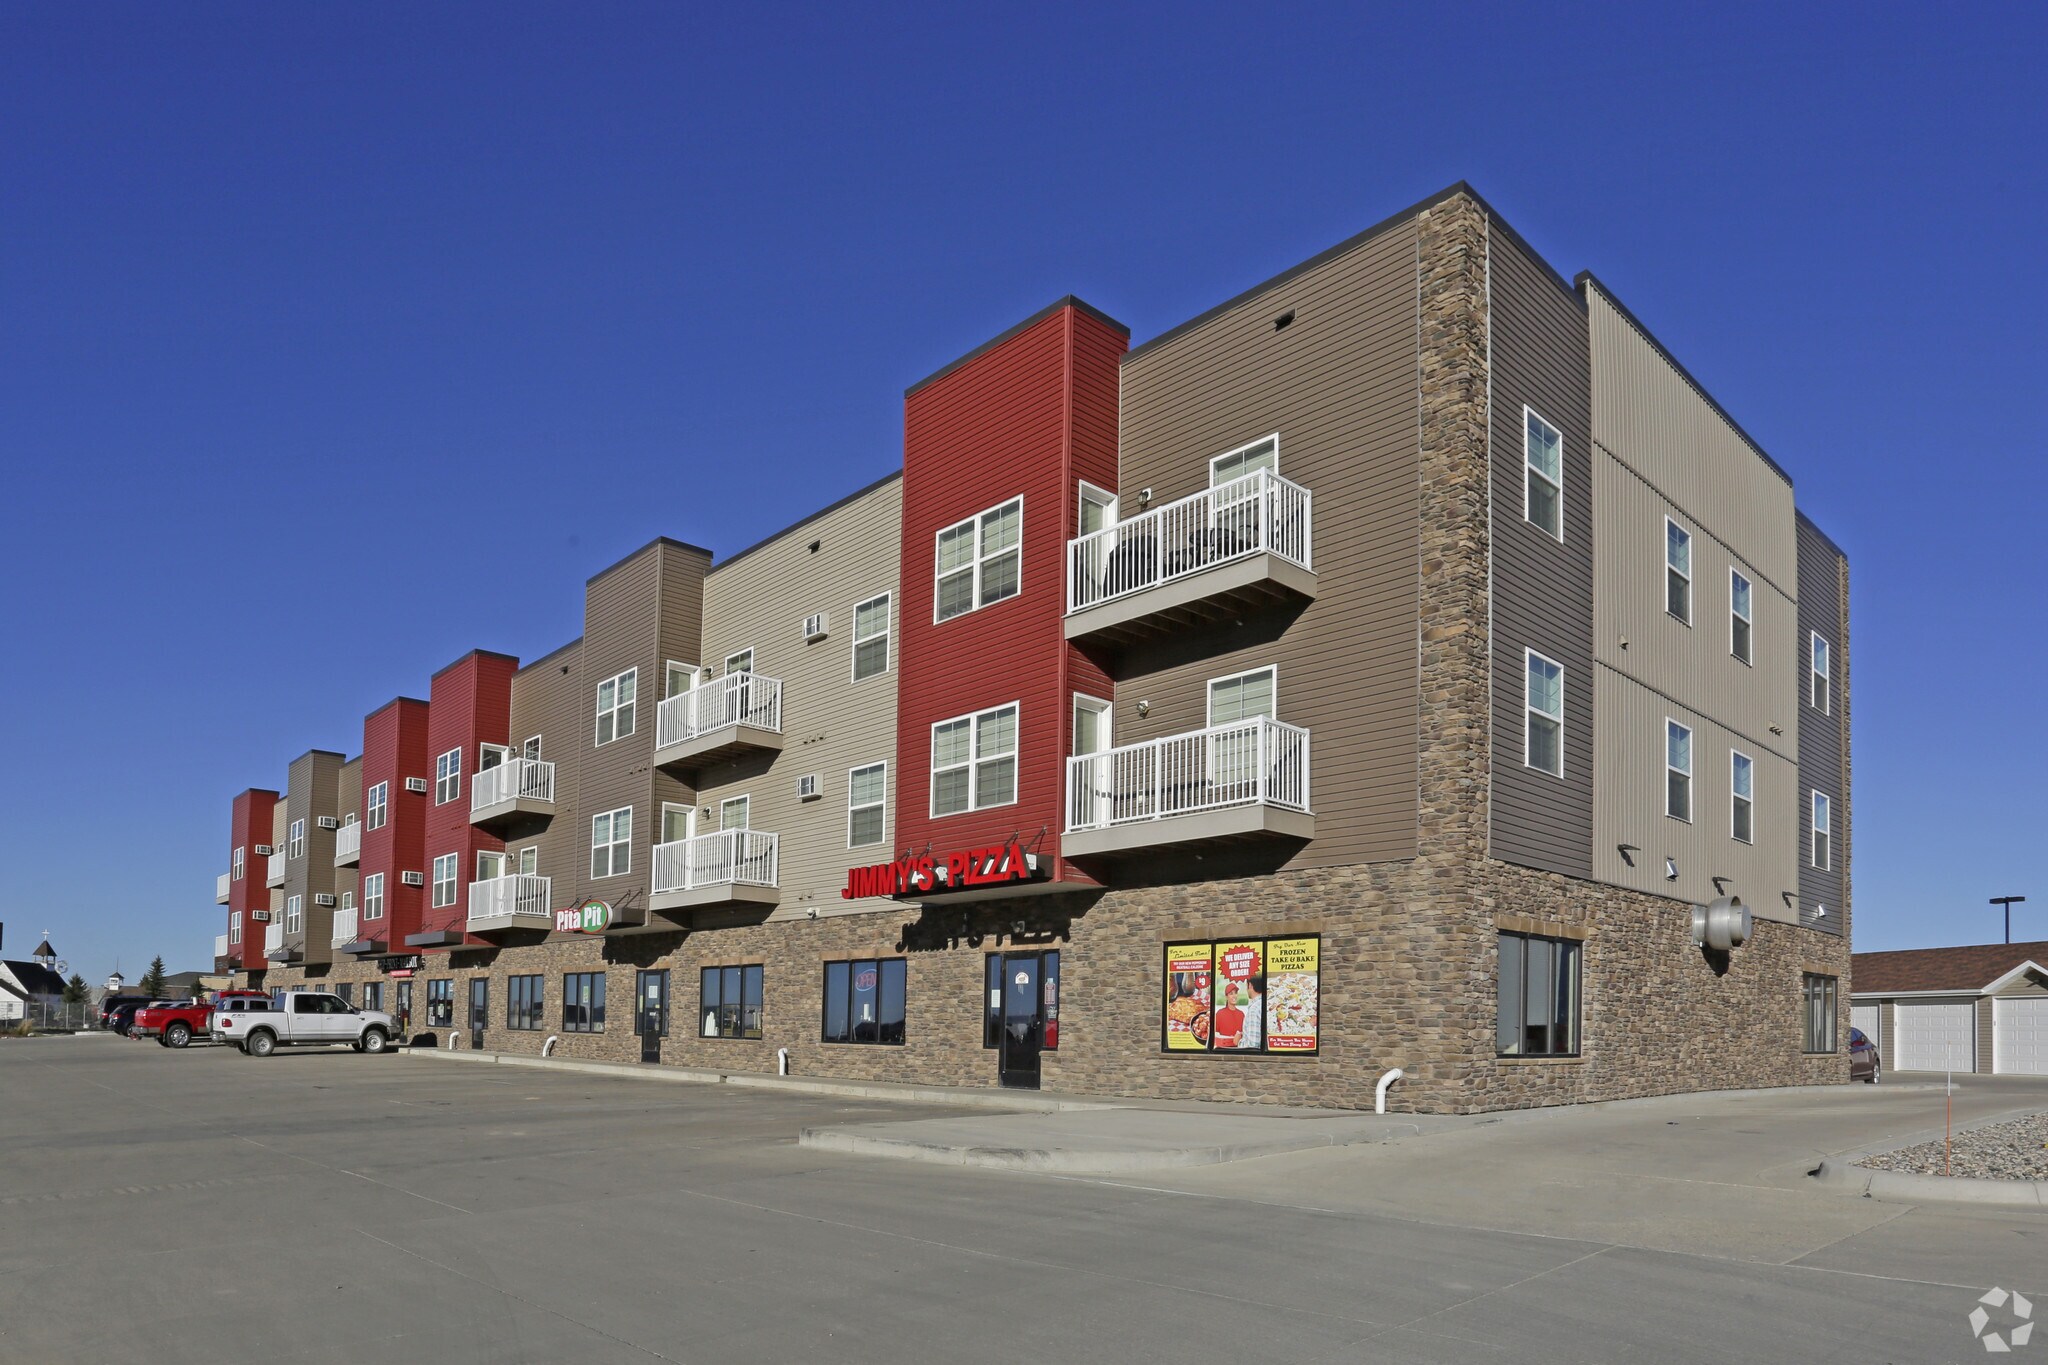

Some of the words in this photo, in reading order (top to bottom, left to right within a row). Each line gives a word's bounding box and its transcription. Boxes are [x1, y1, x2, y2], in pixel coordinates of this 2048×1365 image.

[841, 857, 936, 899] JIMMY'S
[947, 843, 1029, 888] PIZZA
[556, 909, 581, 931] Pita
[584, 906, 602, 928] Pit
[1225, 954, 1233, 962] WE
[1233, 952, 1253, 960] DELIVER
[1229, 961, 1239, 969] ANY
[1239, 960, 1250, 968] SIZE
[1230, 968, 1250, 977] ORDER!
[857, 973, 876, 987] OPEN
